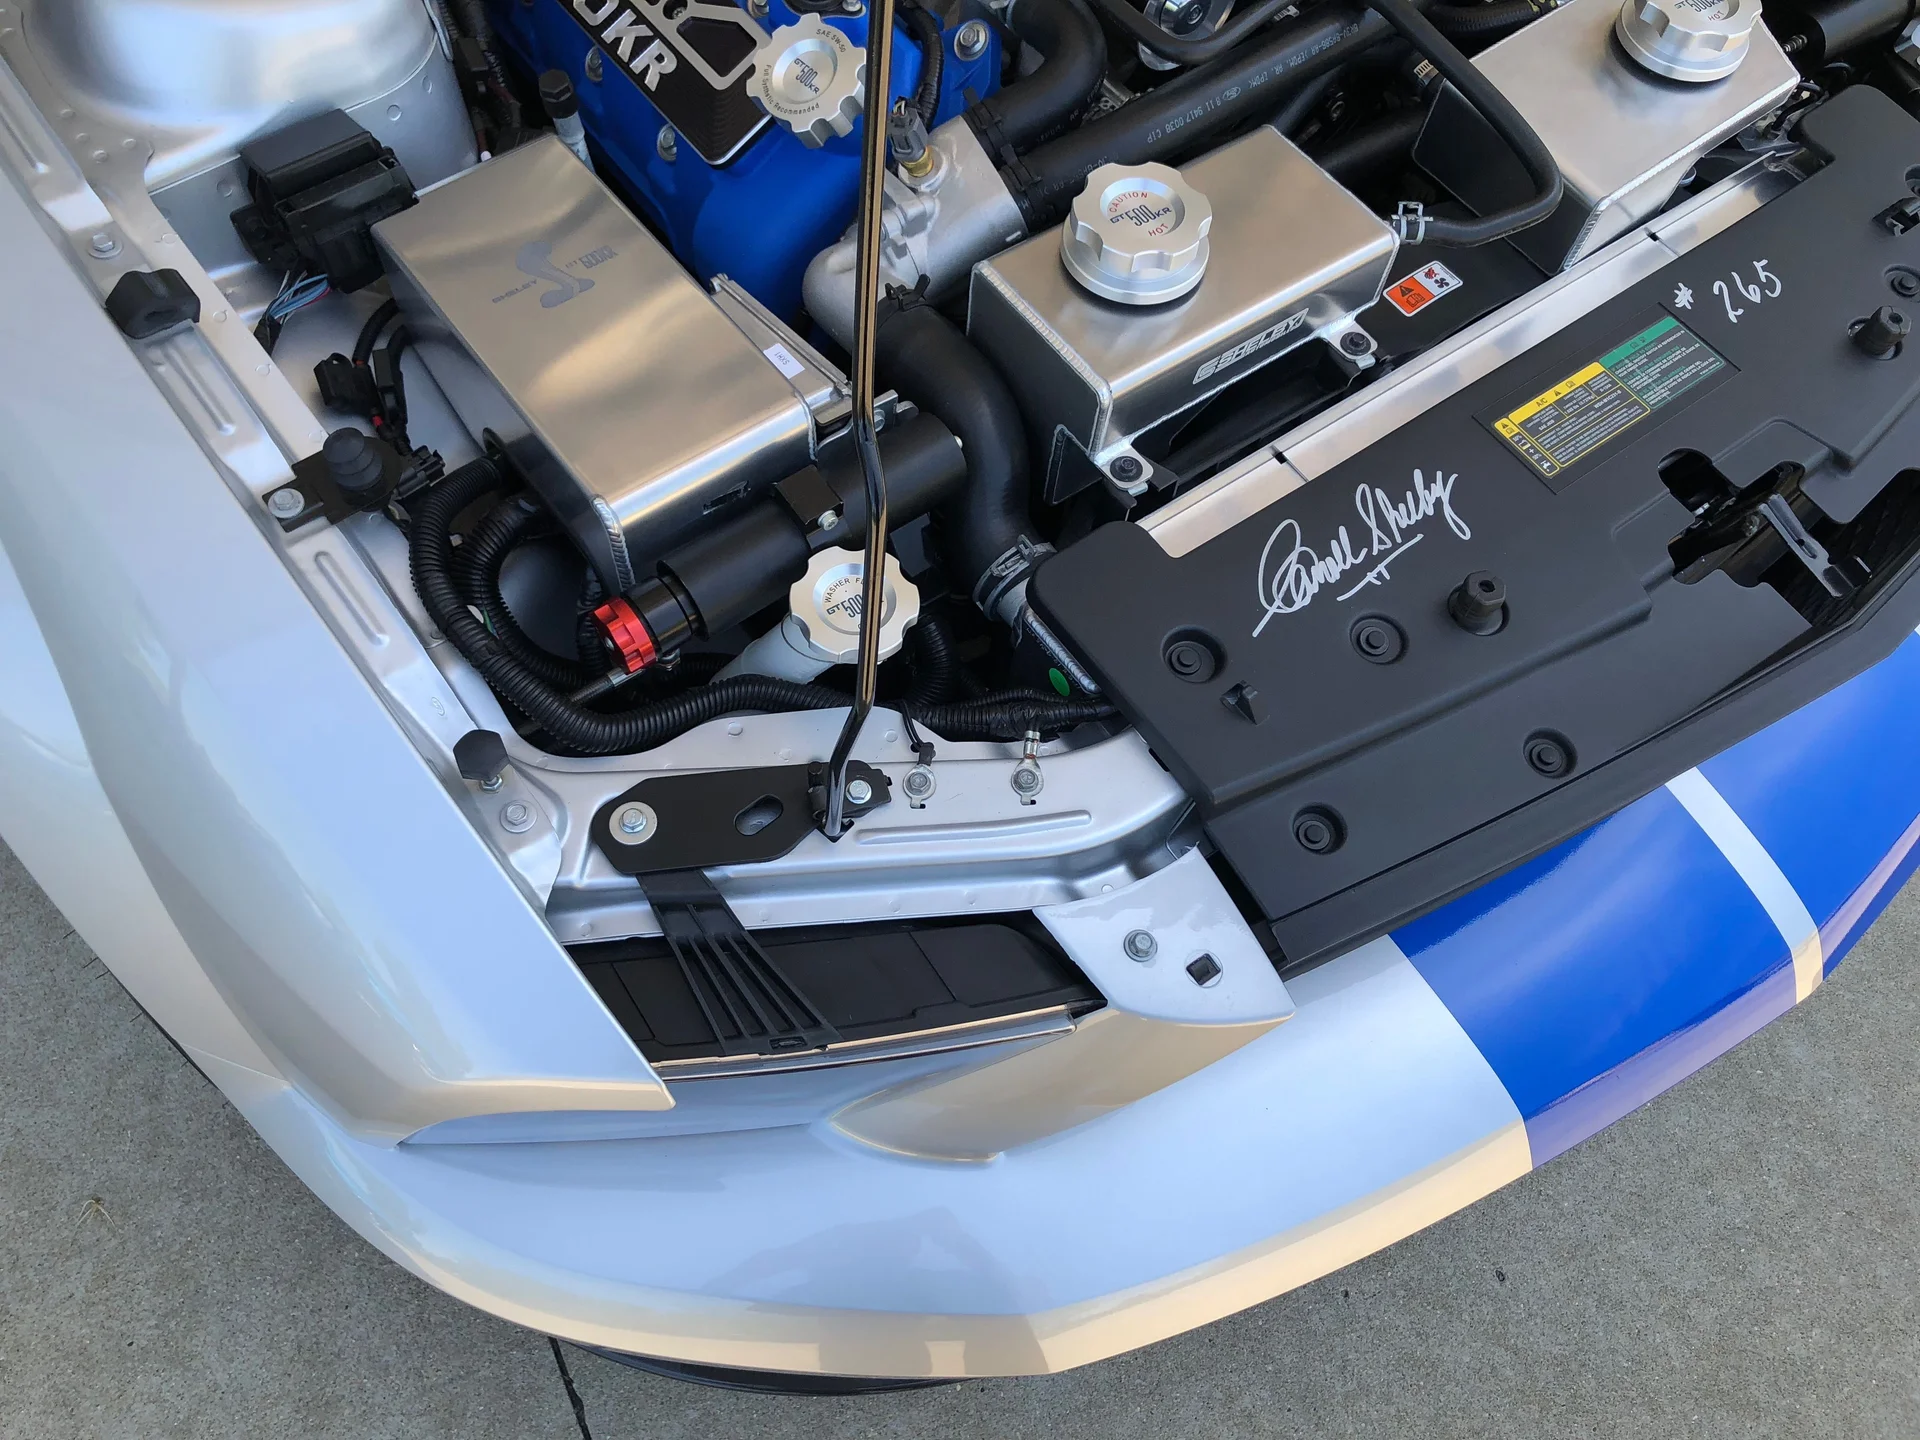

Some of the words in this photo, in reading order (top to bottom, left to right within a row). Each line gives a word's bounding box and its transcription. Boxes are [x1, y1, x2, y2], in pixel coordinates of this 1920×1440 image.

[1708, 10, 1725, 21] HOT
[815, 28, 831, 38] SAE
[831, 34, 847, 53] 5W-50
[763, 64, 772, 78] Full
[761, 78, 774, 105] Synthetic
[773, 102, 820, 115] Recommended
[1186, 106, 1203, 122] 9417
[1165, 117, 1184, 133] 0038
[1109, 191, 1149, 213] CAUTION
[1148, 223, 1169, 237] HOT
[1712, 259, 1782, 323] 265
[1534, 397, 1548, 406] A/C
[1355, 468, 1471, 556] Shelby
[824, 577, 851, 603] WASHER
